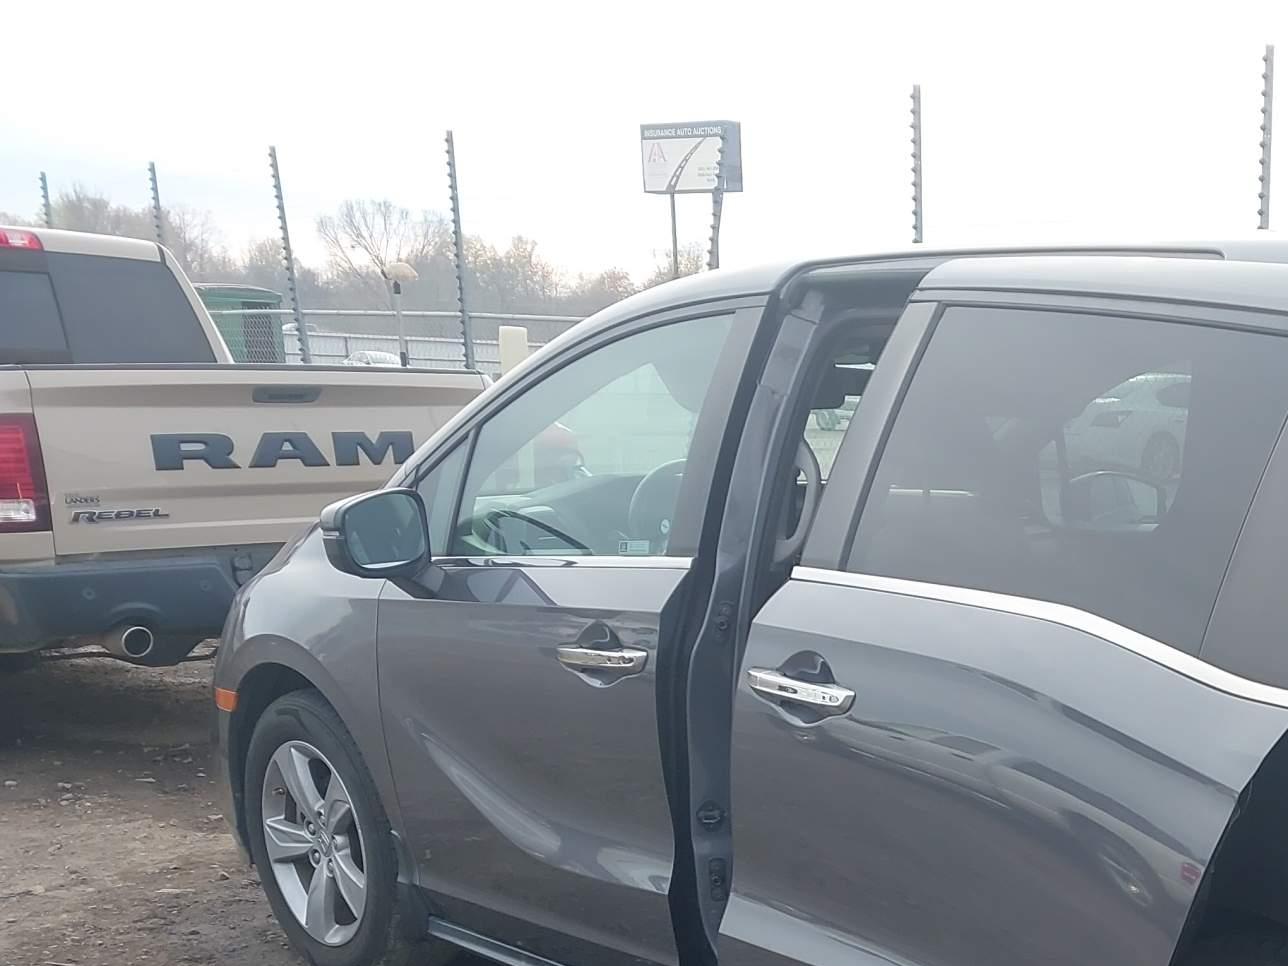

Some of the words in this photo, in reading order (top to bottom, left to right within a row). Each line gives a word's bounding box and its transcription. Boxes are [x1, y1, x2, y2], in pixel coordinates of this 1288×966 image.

[677, 127, 692, 136] AUTO
[693, 126, 722, 135] AUCTIONS
[150, 431, 415, 471] RAM
[70, 508, 169, 524] REBEL
